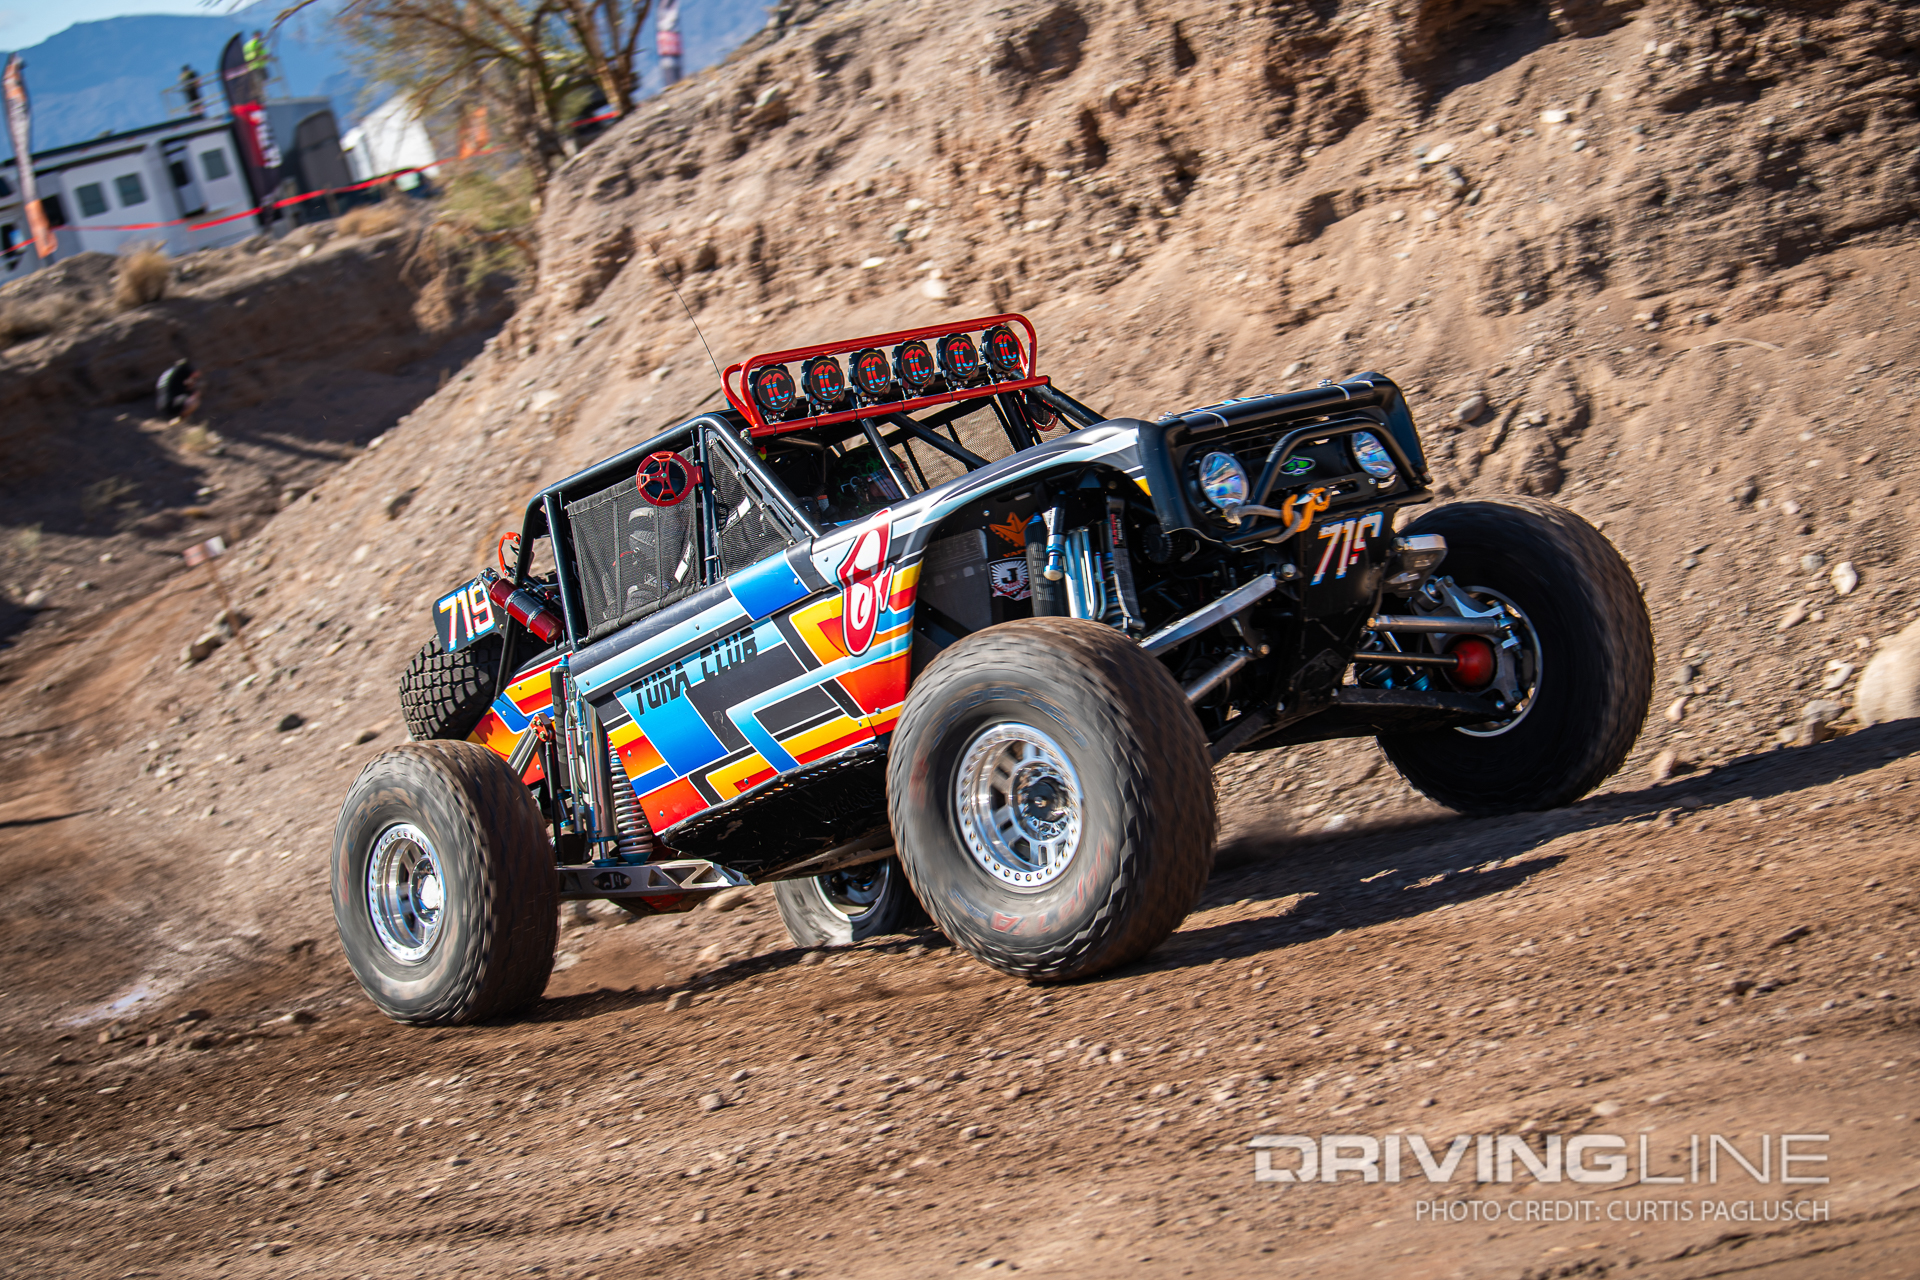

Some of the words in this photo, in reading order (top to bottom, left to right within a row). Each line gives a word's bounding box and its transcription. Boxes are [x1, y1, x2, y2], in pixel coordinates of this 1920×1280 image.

[904, 348, 930, 380] TC
[948, 340, 974, 372] TC
[995, 333, 1017, 364] TC
[813, 365, 840, 397] TC
[860, 356, 886, 389] TC
[760, 373, 790, 406] TC
[438, 581, 495, 652] 719
[630, 661, 691, 715] TUNA
[700, 627, 757, 681] CLUB
